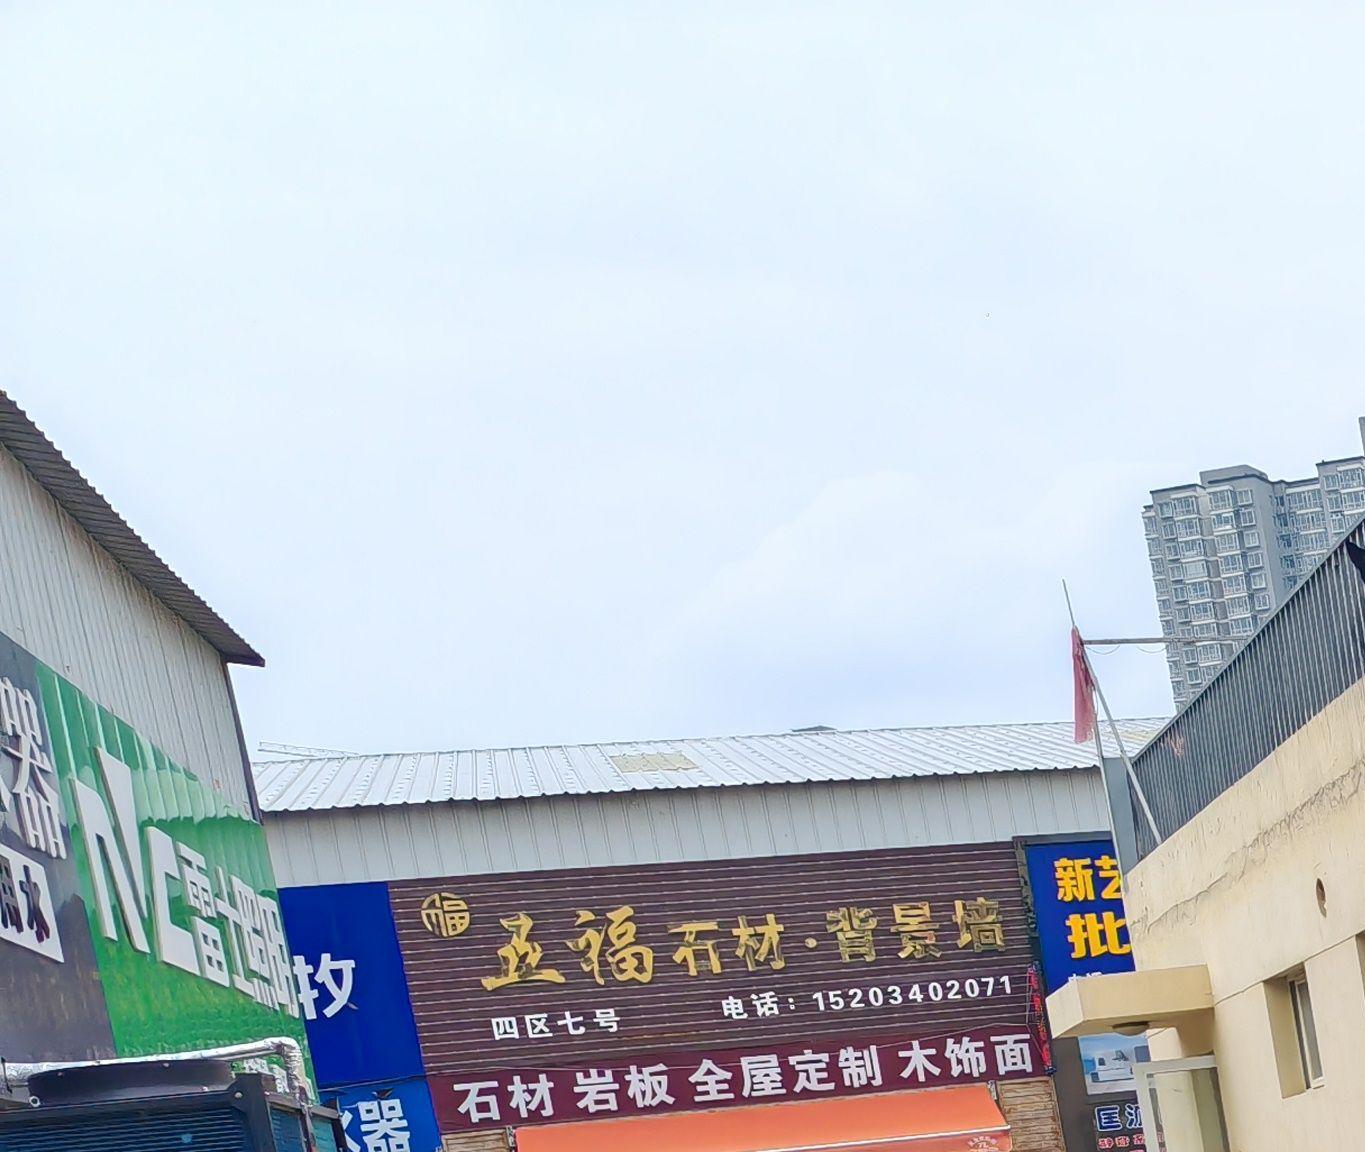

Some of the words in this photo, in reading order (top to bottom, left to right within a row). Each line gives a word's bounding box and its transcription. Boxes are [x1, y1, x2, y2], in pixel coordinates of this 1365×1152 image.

[176, 841, 299, 1018] 雷士照明
[490, 1008, 621, 1040] 四区七号
[453, 1074, 554, 1123] 石材
[573, 1063, 676, 1114] 岩板
[689, 1045, 883, 1102] 全屋定制
[898, 1033, 1033, 1082] 木饰面
